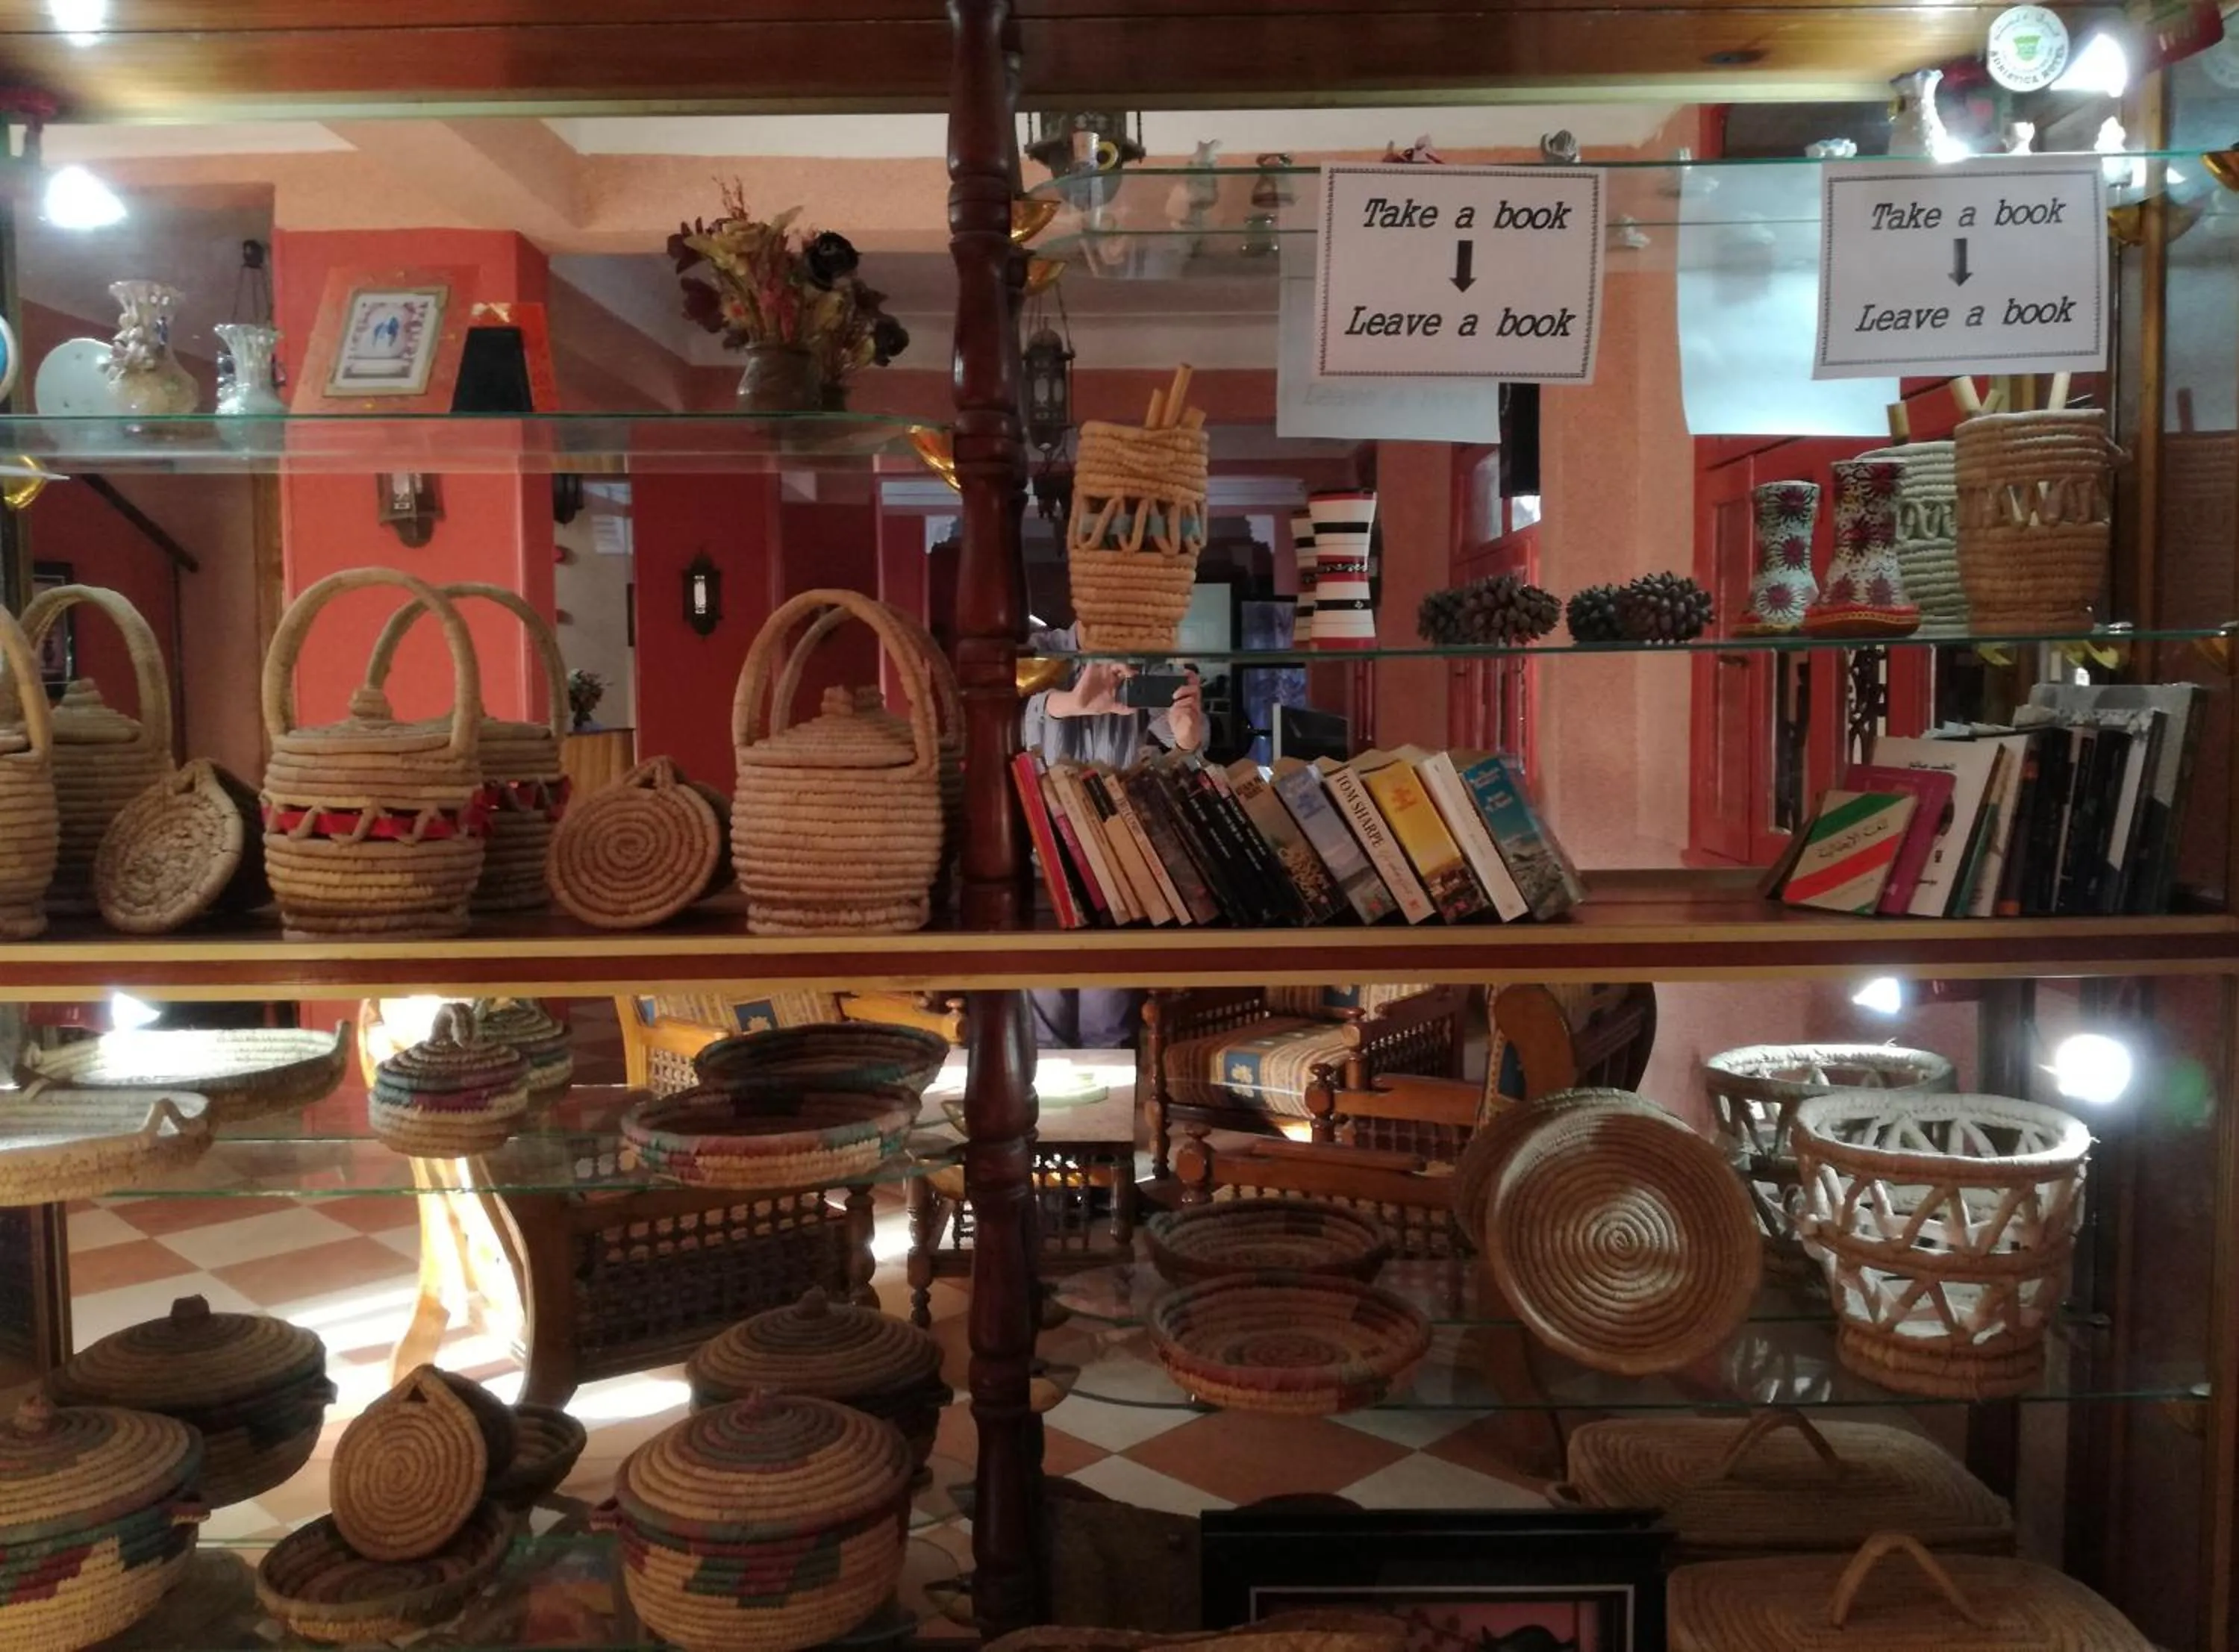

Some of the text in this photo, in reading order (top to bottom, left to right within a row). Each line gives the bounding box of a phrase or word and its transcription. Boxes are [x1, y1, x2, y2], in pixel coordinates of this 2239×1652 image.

[1362, 198, 1573, 231] Take a book
[1871, 197, 2067, 231] Take a book
[1343, 305, 1577, 338] Leave a book
[1855, 295, 2077, 332] Leave a book
[1335, 772, 1385, 848] TOM SHARPE
